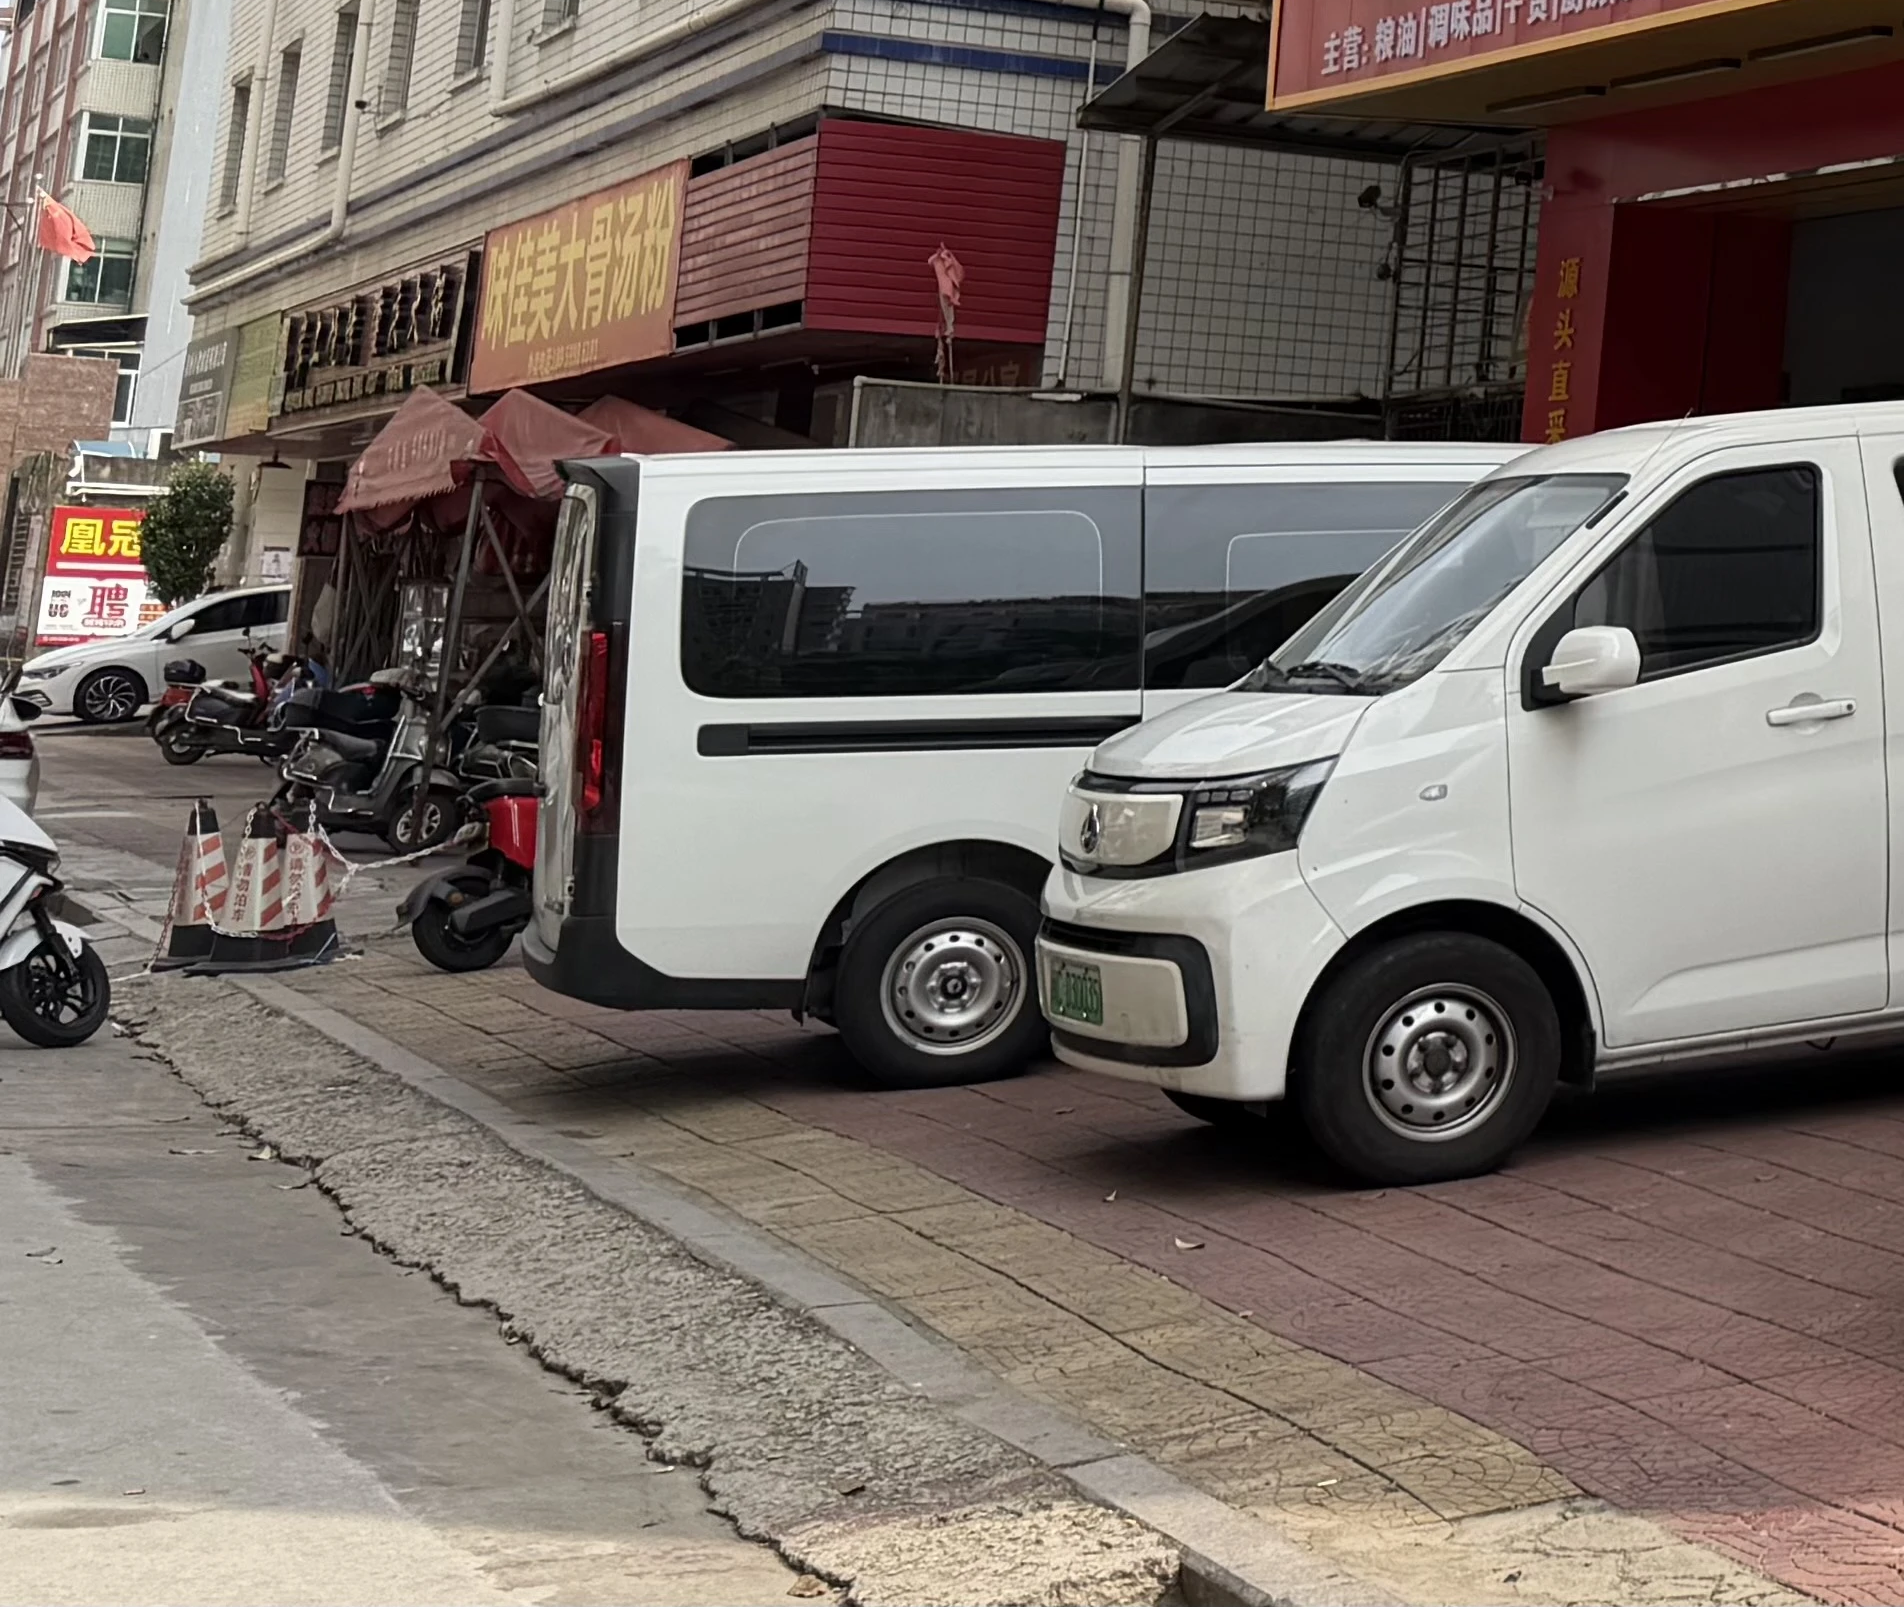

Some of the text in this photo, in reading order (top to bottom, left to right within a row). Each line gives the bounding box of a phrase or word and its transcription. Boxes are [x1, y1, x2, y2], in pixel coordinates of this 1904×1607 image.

[481, 176, 676, 351] 味佳美大骨汤粉
[83, 583, 128, 619] 聘
